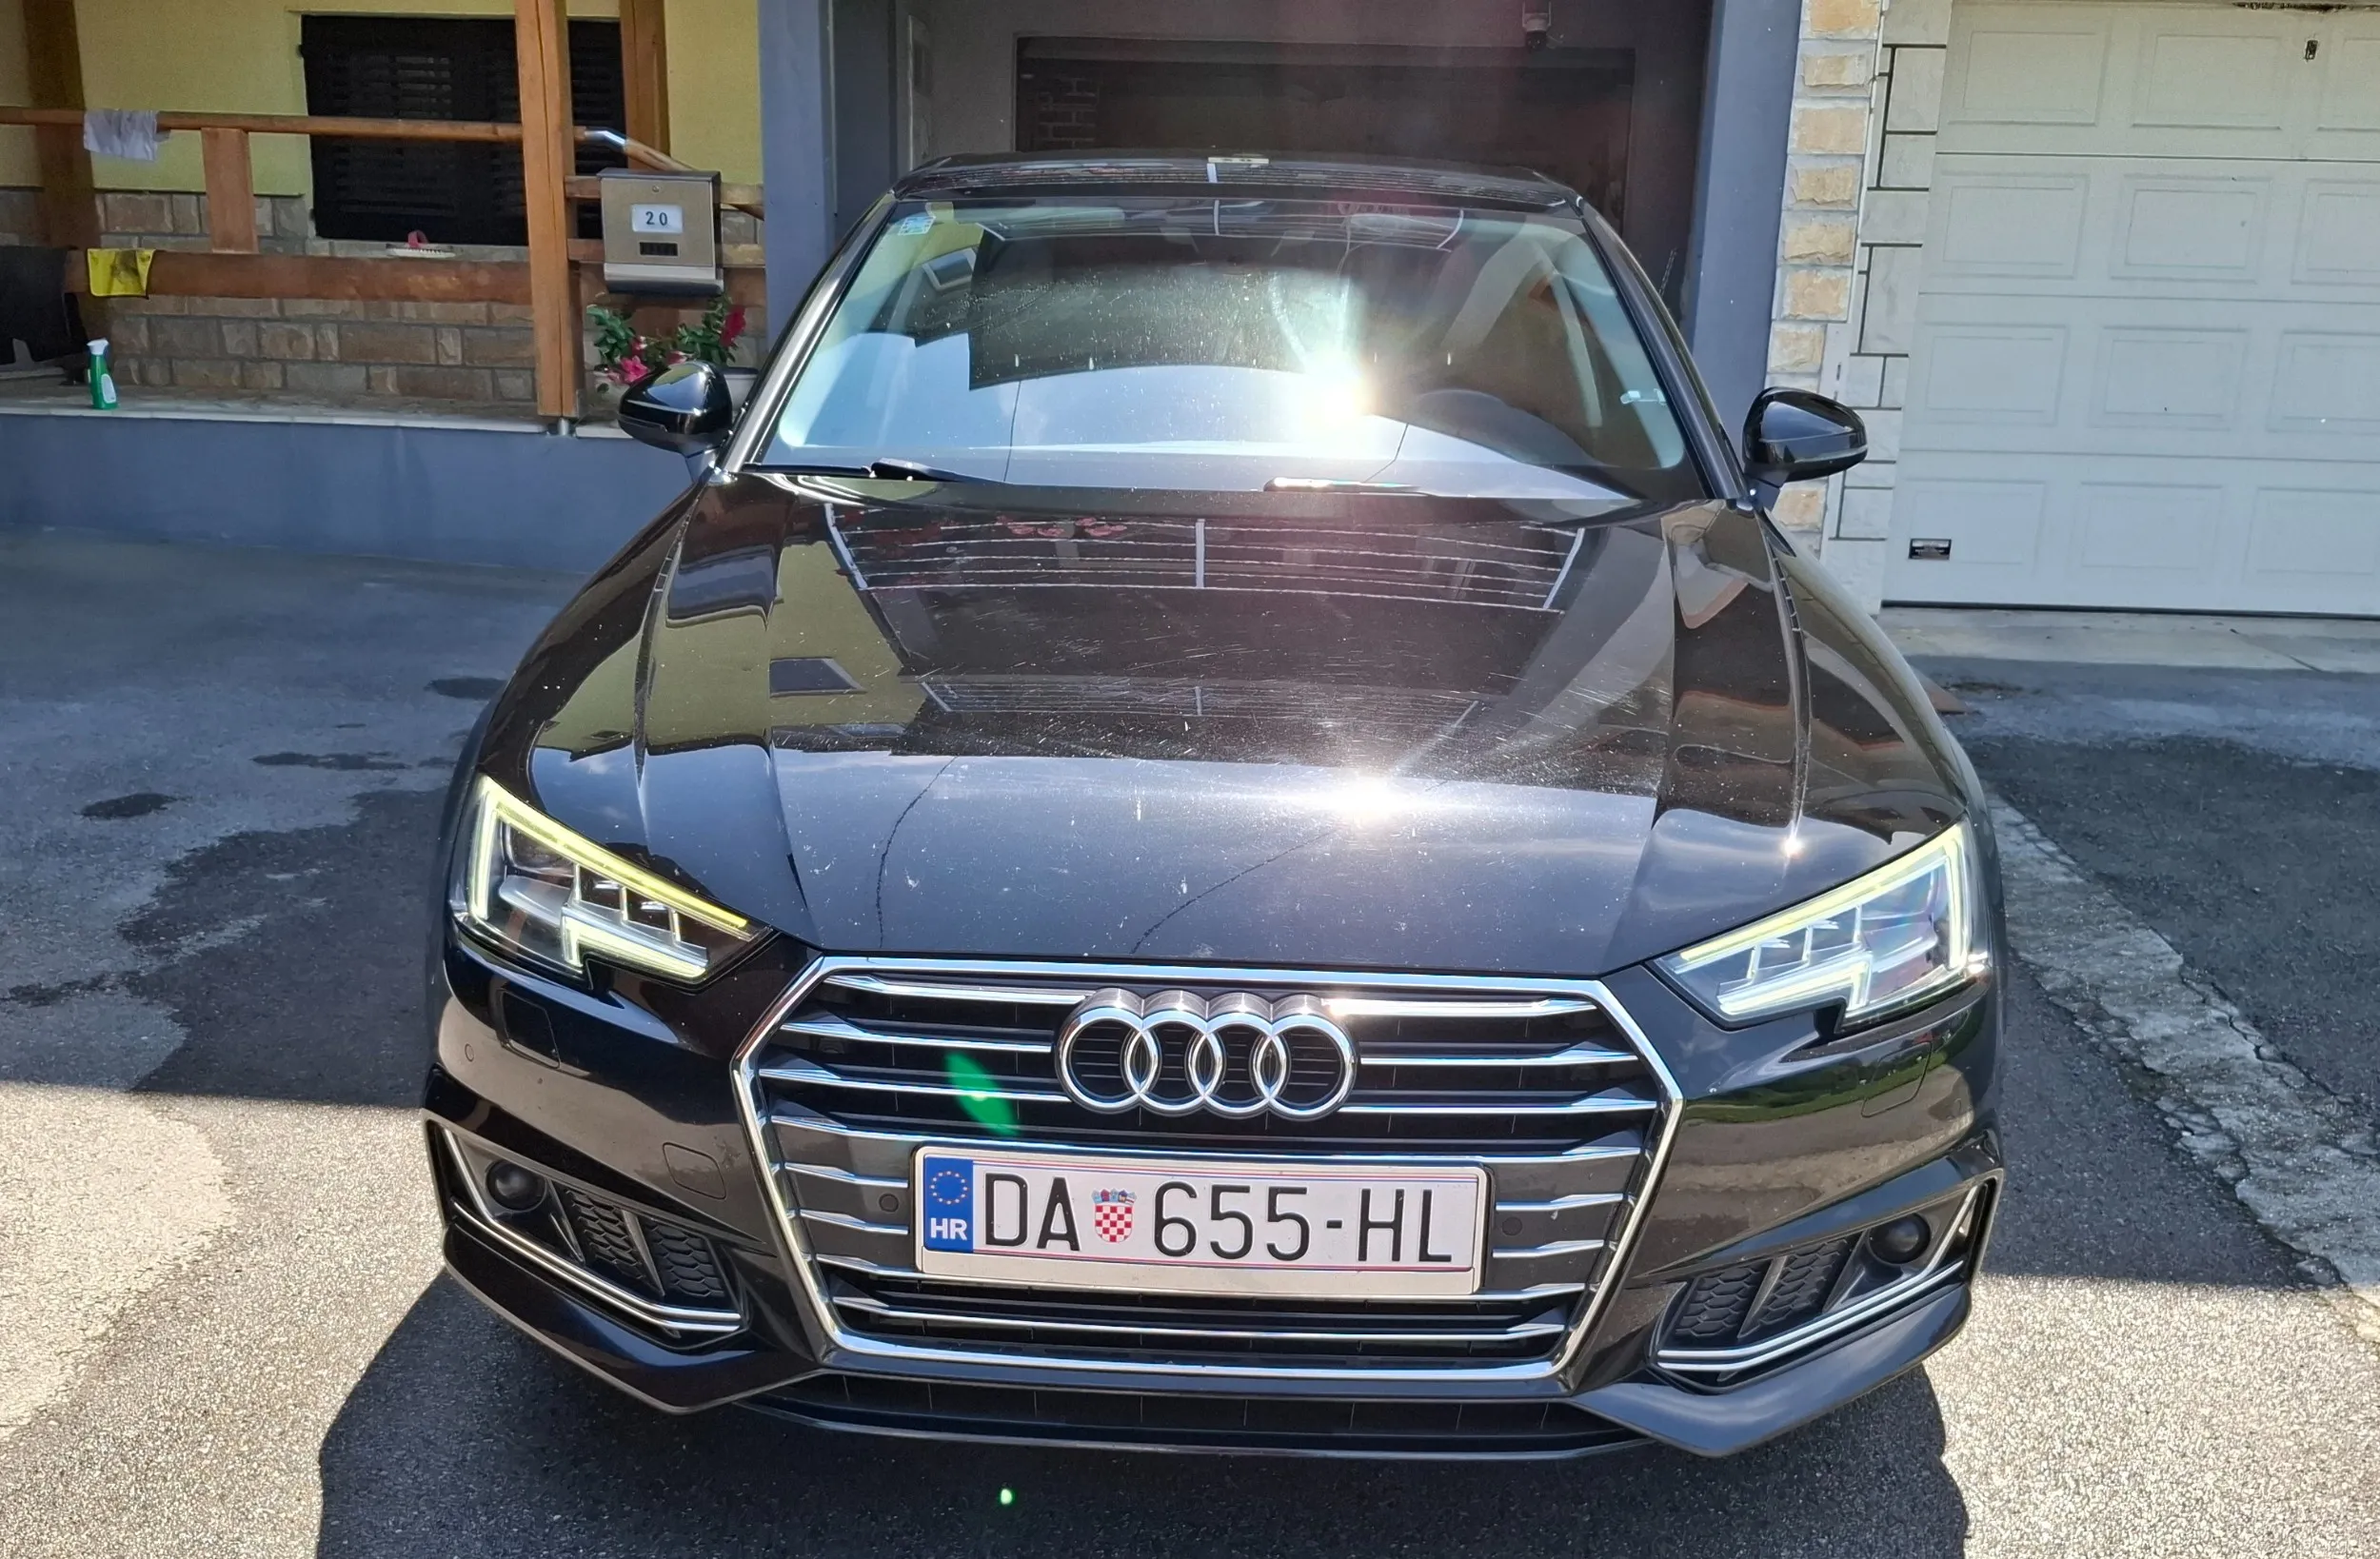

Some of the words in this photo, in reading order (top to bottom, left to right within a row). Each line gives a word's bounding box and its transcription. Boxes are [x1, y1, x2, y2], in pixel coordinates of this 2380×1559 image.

[645, 211, 668, 227] 20
[929, 1216, 968, 1241] HR
[983, 1172, 1081, 1252] DA
[1153, 1180, 1453, 1262] 655-HL
